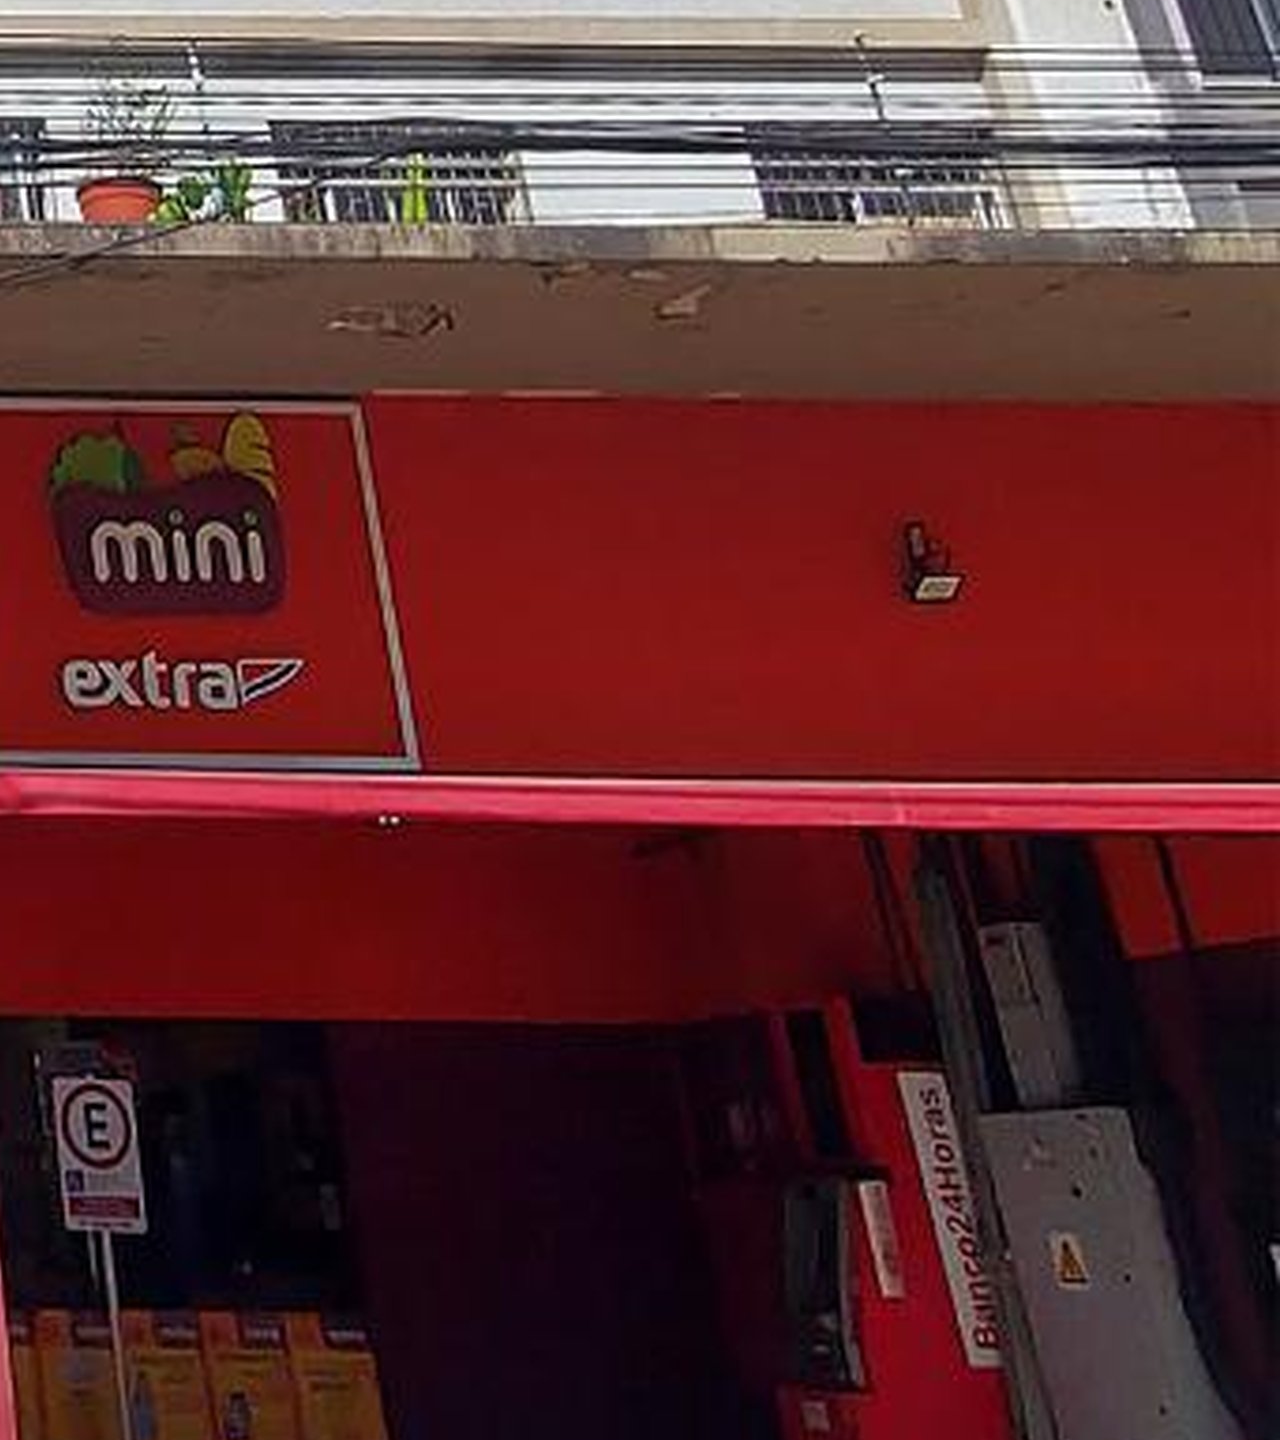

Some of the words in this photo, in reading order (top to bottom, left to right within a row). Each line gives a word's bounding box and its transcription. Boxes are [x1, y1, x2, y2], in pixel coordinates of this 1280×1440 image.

[91, 509, 266, 583] mini
[62, 650, 239, 710] extra
[83, 1102, 111, 1150] E
[920, 1086, 1001, 1350] Banco24Horas
